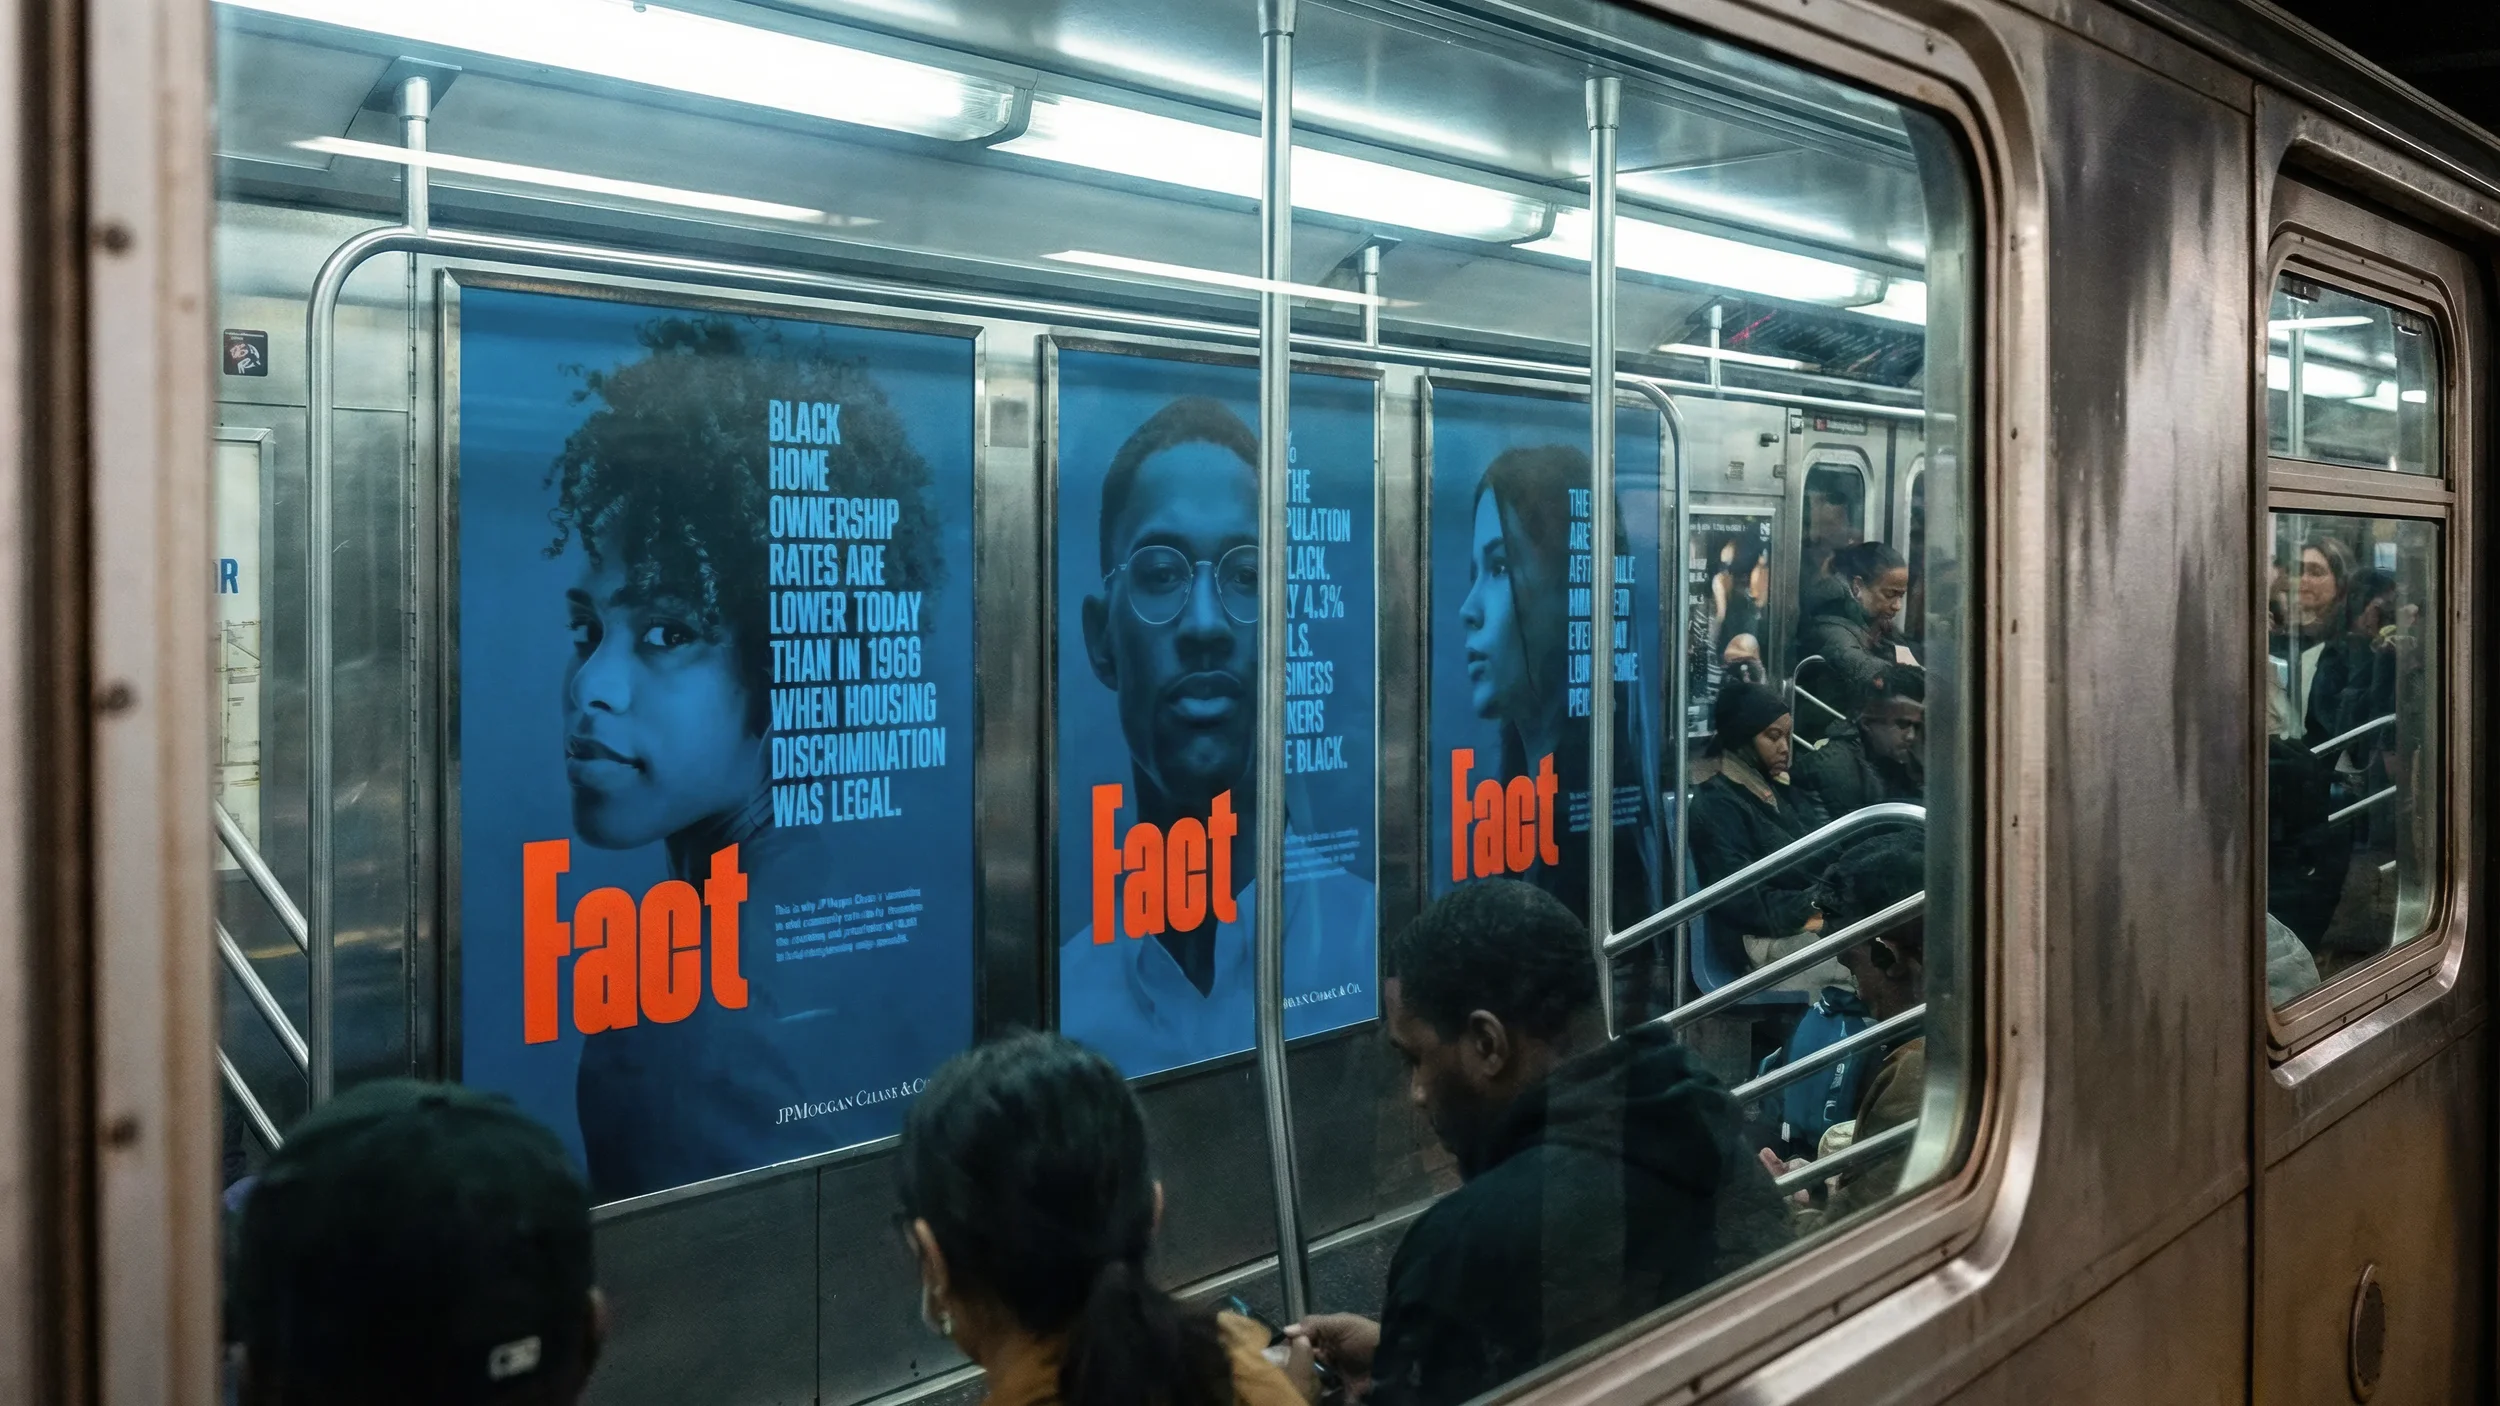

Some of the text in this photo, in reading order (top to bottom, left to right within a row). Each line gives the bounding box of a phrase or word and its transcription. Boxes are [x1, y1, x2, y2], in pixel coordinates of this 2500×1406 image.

[769, 400, 841, 445] BLACK
[769, 447, 830, 491] HOME
[769, 495, 900, 540] OWNERSHIP
[1286, 507, 1350, 542] PULATION
[769, 543, 886, 587] RATES ARE
[1286, 545, 1331, 581] LACK.
[769, 591, 922, 635] LOWER TODAY
[1304, 584, 1345, 619] 4.3%
[769, 635, 922, 684] THAN IN 1966
[1286, 660, 1334, 697] SINESS
[770, 681, 937, 731] WHEN HOUSING
[771, 726, 946, 780] DISCRIMINATION
[1296, 735, 1349, 774] BLACK.
[772, 775, 902, 829] WAS LEGAL.
[1452, 748, 1560, 883] Fact
[1092, 783, 1238, 945] Fact
[523, 838, 749, 1045] Fact
